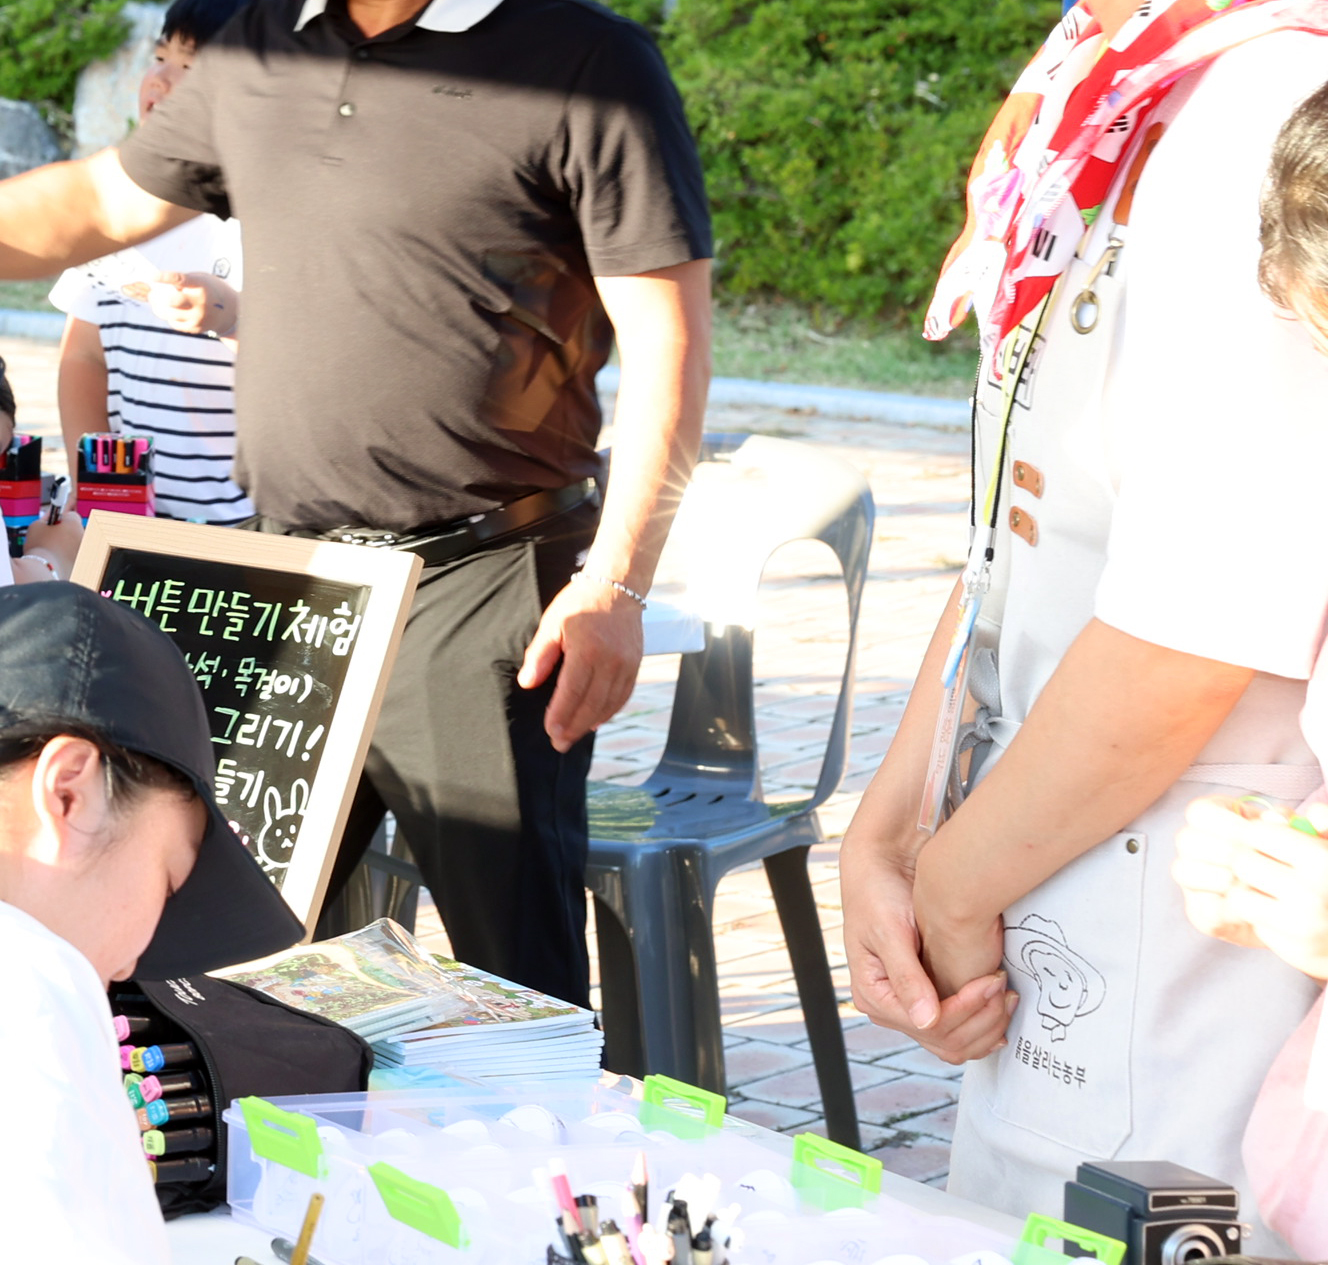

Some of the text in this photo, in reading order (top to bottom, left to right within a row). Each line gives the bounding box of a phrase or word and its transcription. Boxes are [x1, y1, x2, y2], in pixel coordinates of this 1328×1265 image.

[112, 579, 362, 657] 버튼 만들기 체험
[209, 706, 325, 762] 그리기!
[214, 758, 266, 808] 들기
